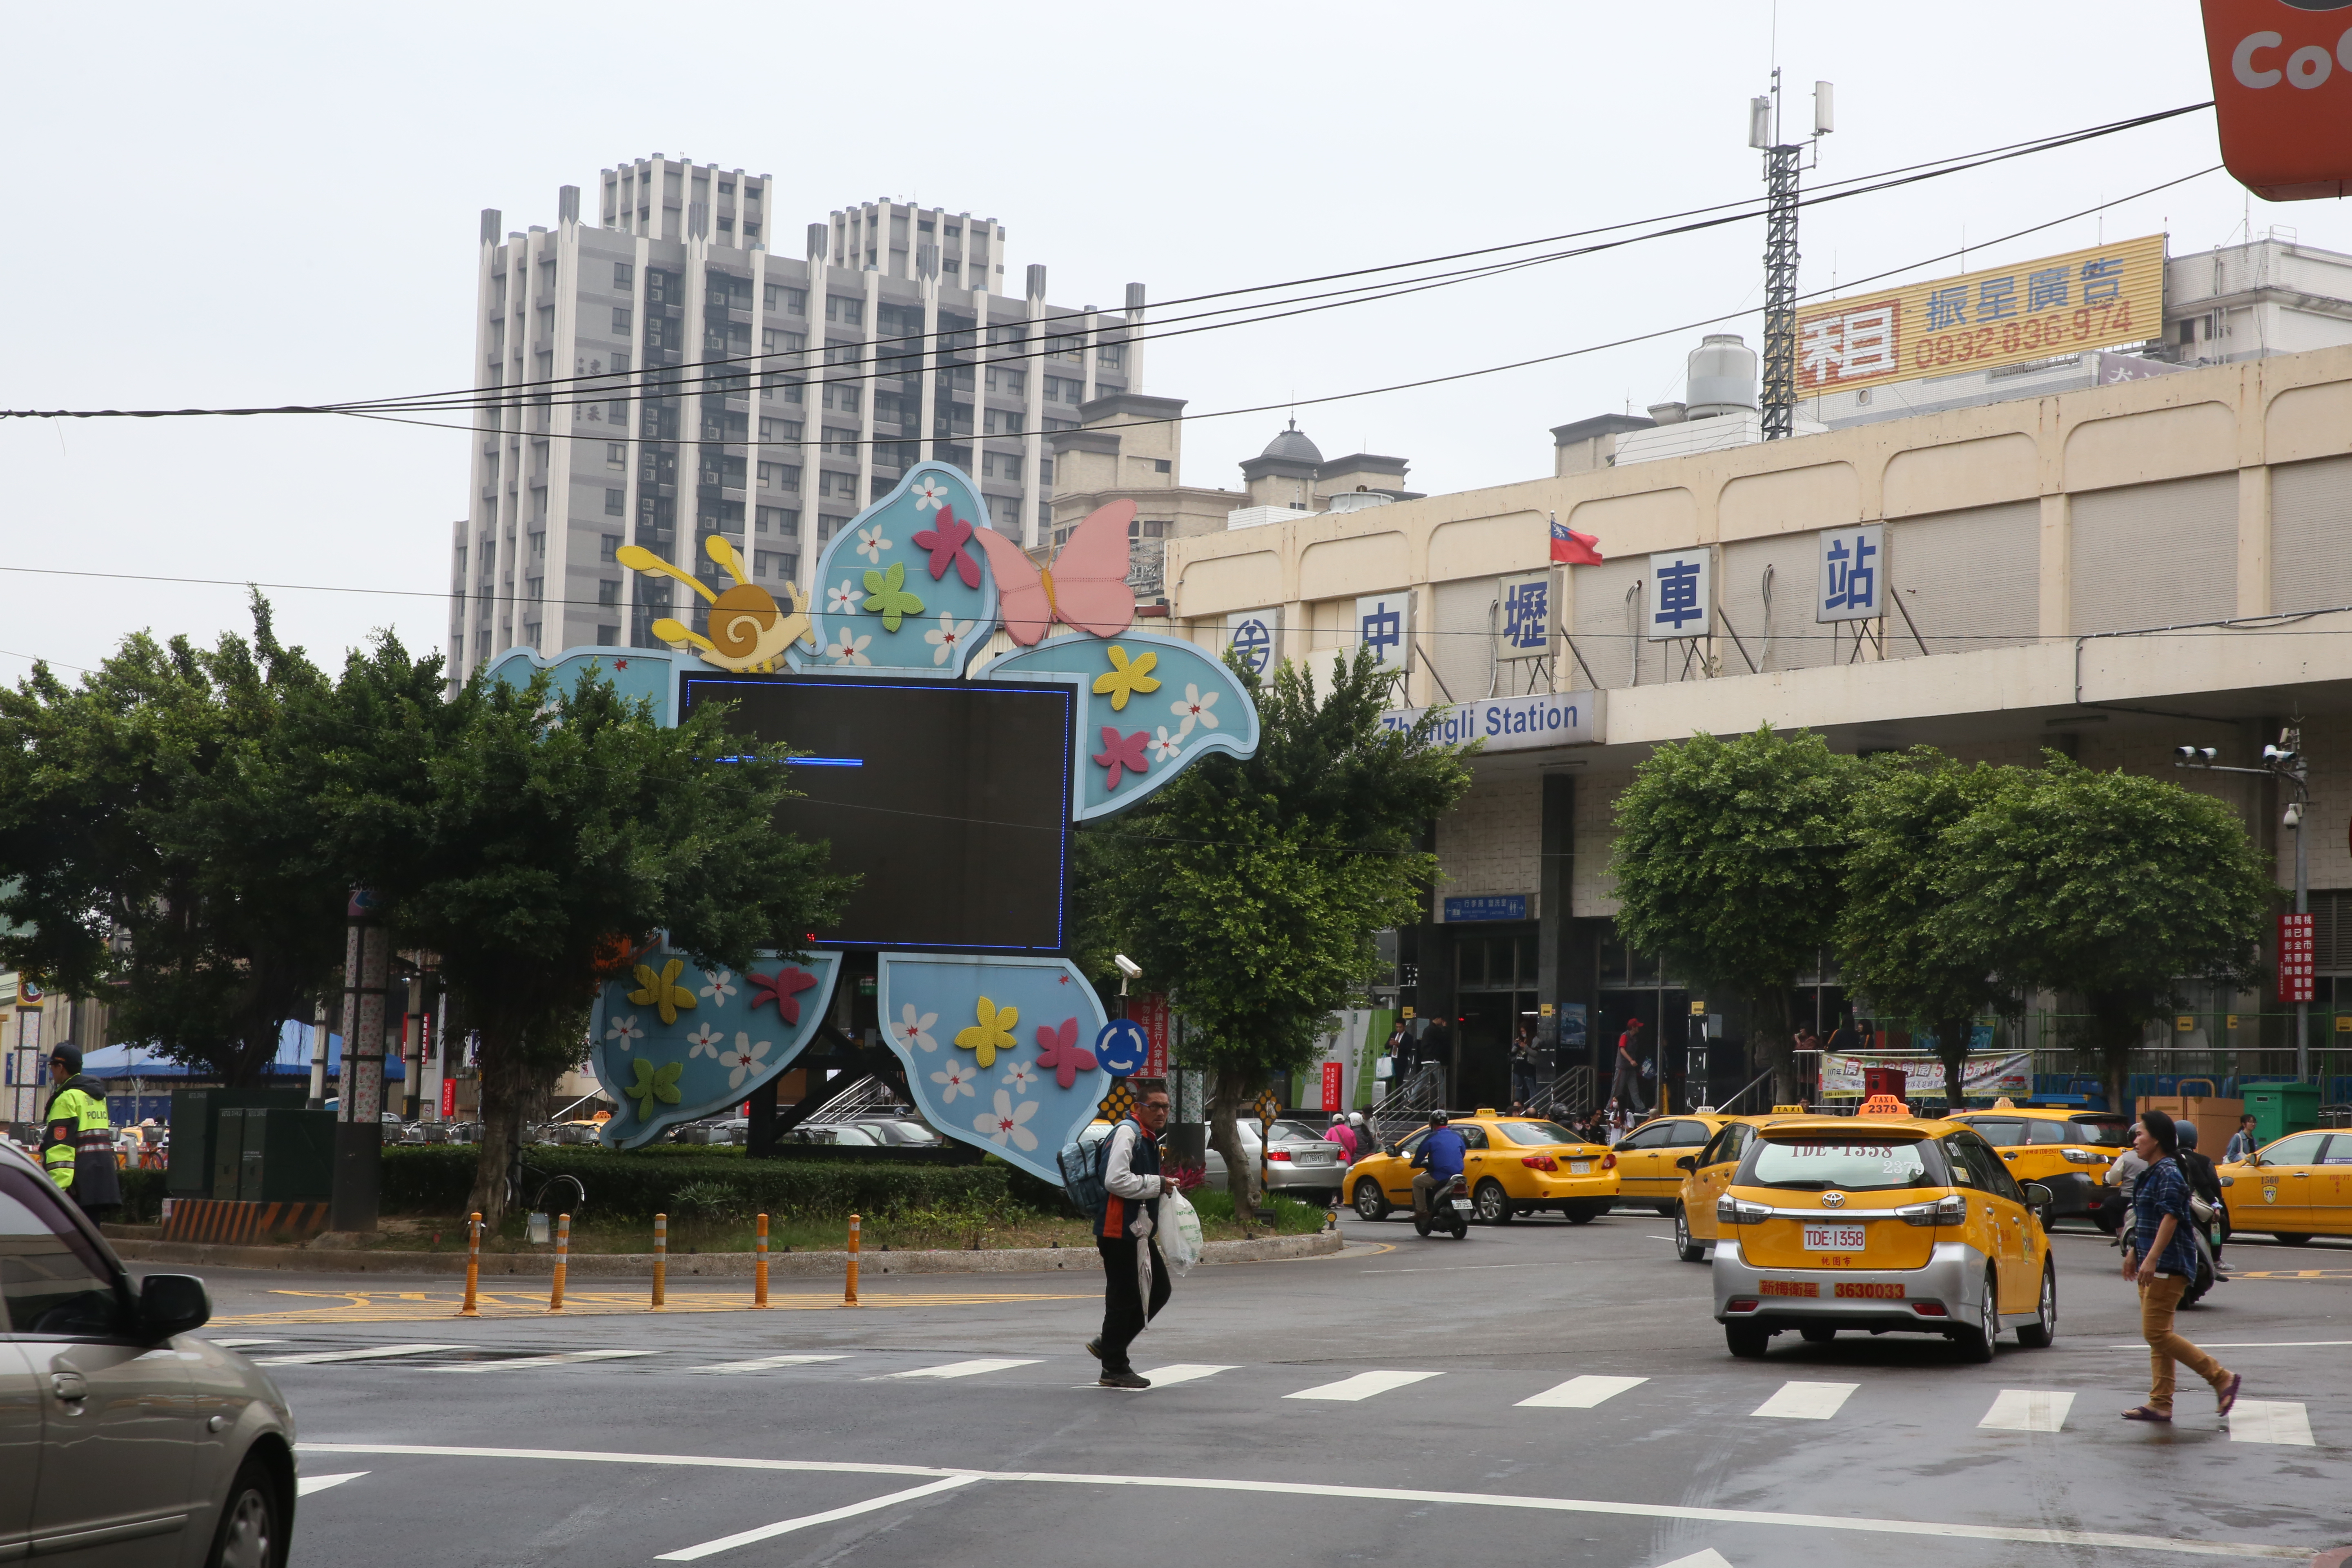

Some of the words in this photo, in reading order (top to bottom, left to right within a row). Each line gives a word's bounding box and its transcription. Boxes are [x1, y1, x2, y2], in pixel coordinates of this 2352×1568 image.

[1926, 258, 2124, 332] 振星廣告
[1915, 300, 2133, 369] 0932-836-974
[1362, 602, 1400, 665] 中
[1503, 581, 1548, 649] 壢
[1655, 560, 1702, 629] 車
[1825, 535, 1876, 610] 站
[1381, 709, 1474, 746] Zhngli
[1486, 702, 1577, 736] Station
[1868, 1105, 1898, 1113] 2379
[1791, 1141, 1893, 1158] TDE-1358
[1882, 1160, 1925, 1176] 2379
[2261, 1176, 2279, 1184] 1560
[1821, 1256, 1851, 1267] 桃園市
[1761, 1281, 1817, 1298] 新梅衛星
[1835, 1283, 1904, 1298] 3630033
